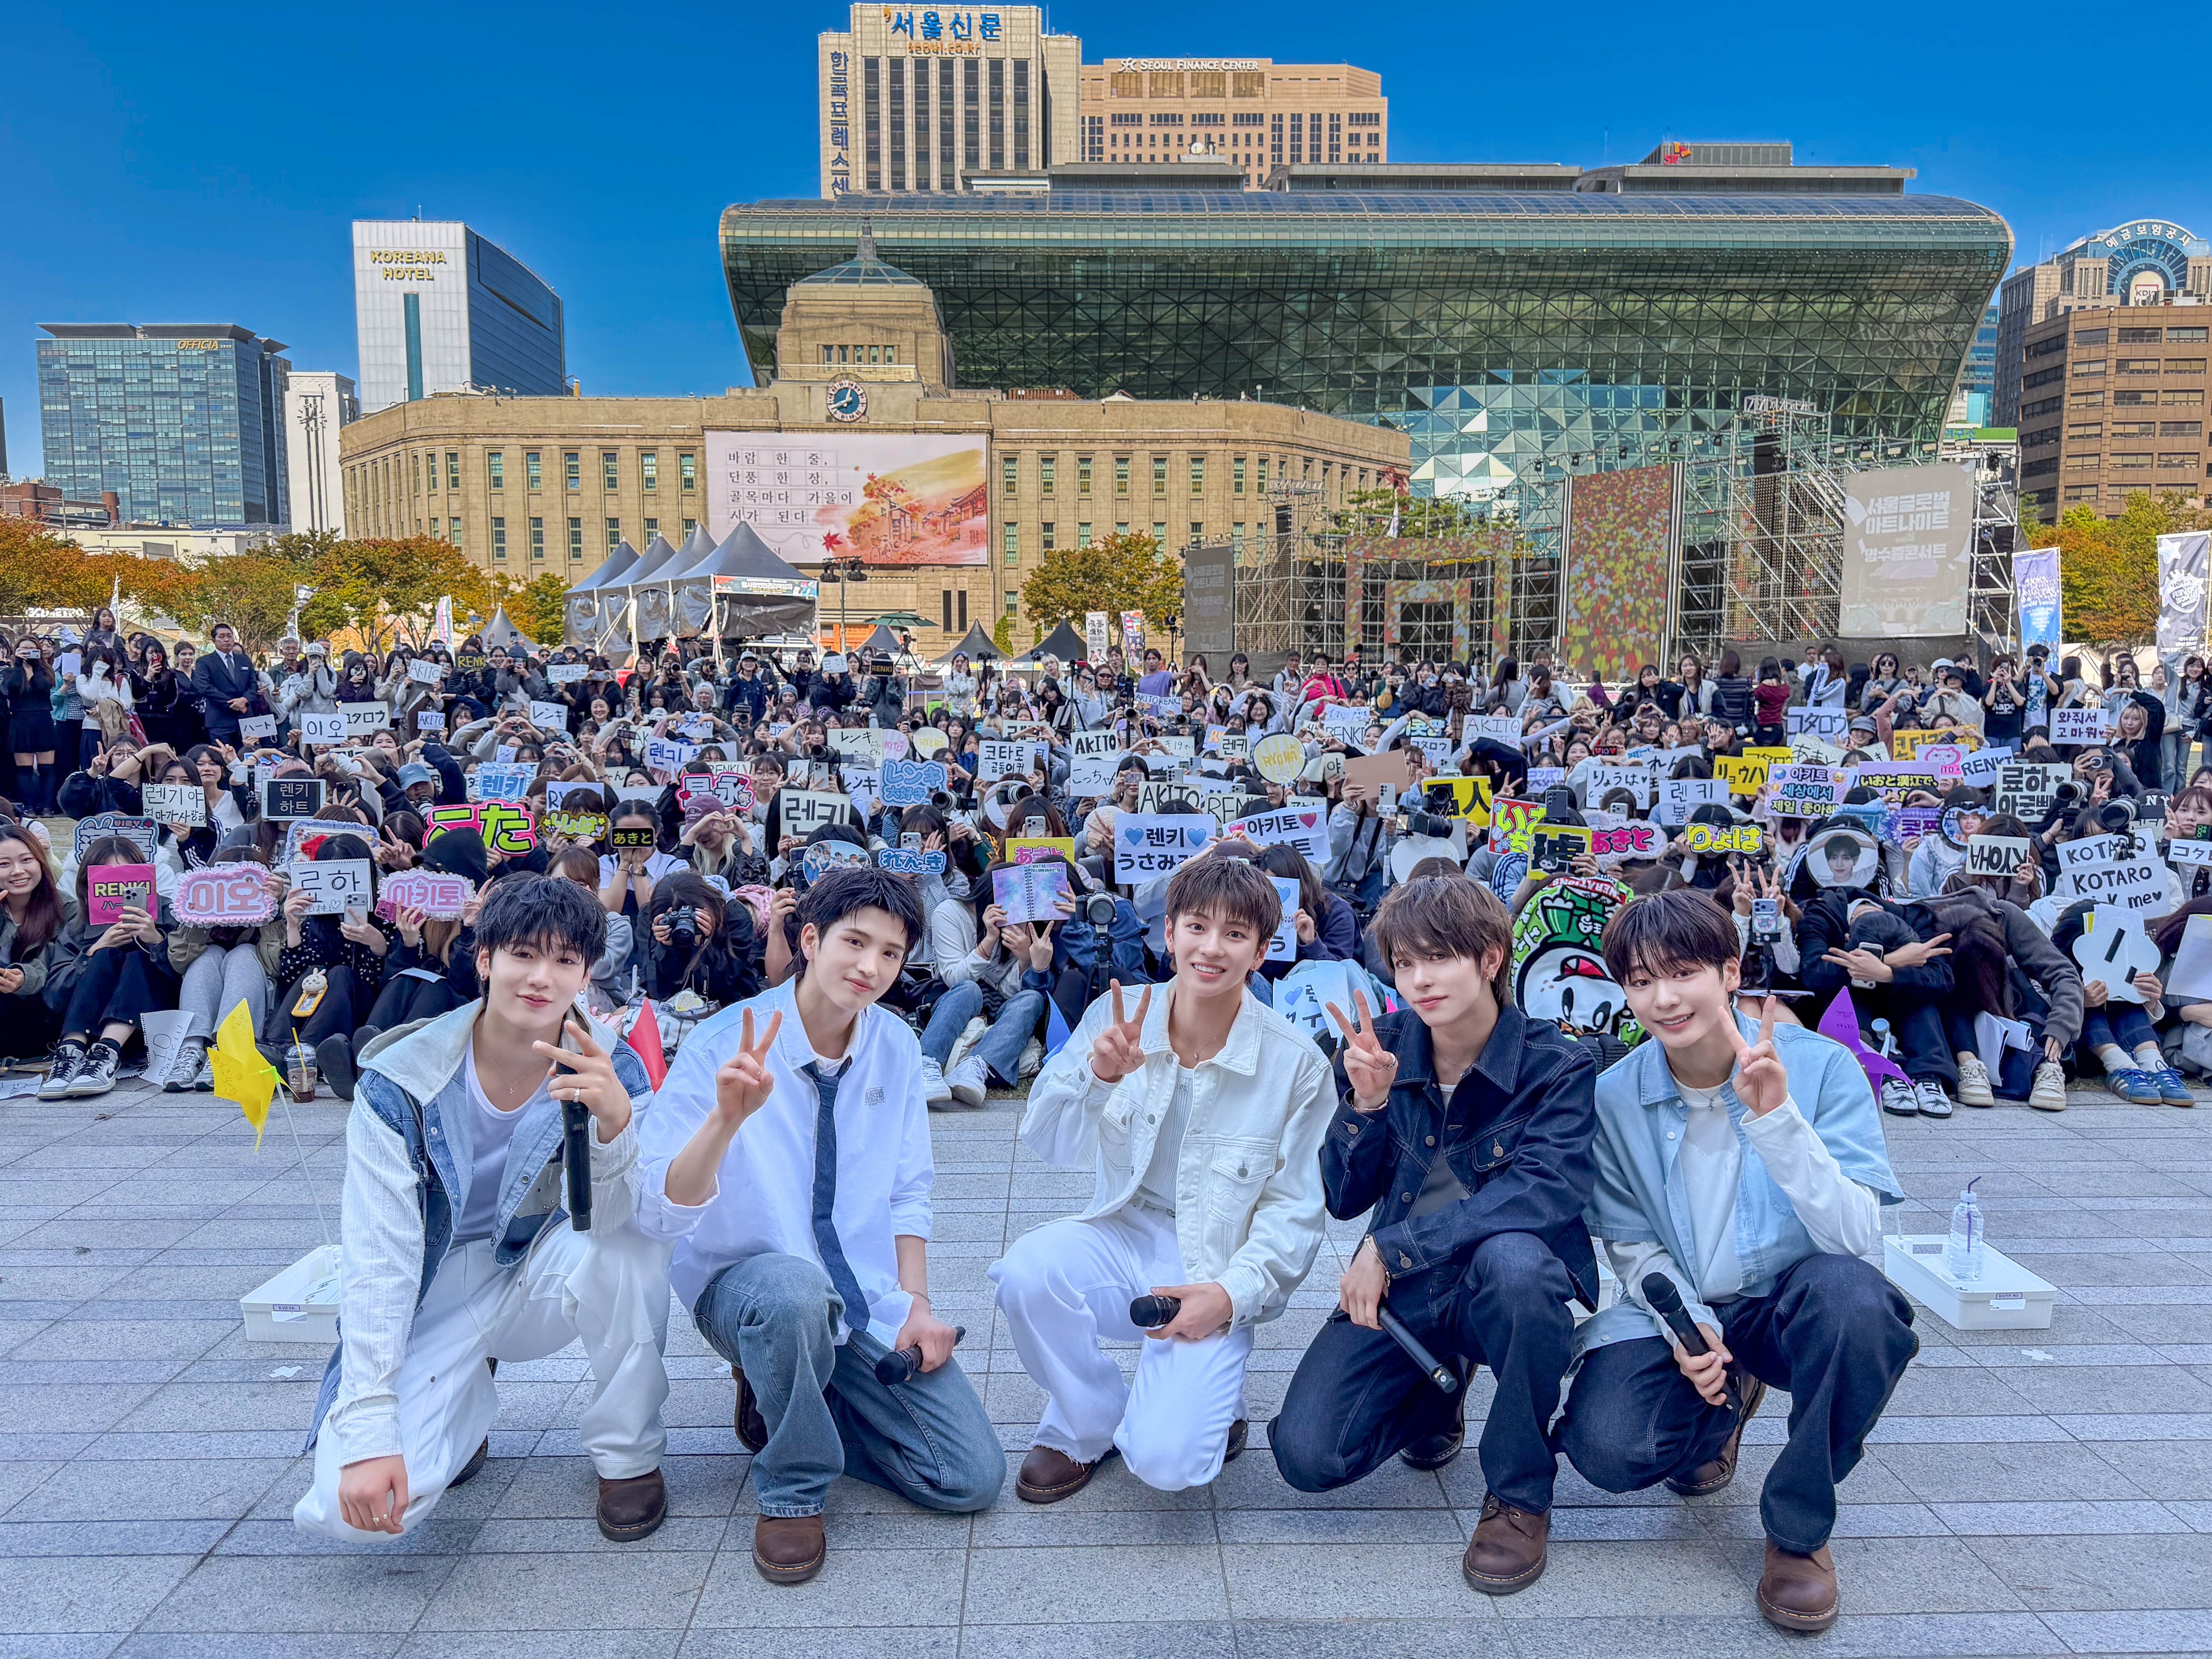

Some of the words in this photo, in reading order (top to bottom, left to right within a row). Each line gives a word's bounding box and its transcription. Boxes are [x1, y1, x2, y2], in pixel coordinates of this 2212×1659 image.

[891, 11, 1002, 41] 서울신문
[909, 40, 981, 56] seoul.co.kr
[1140, 60, 1174, 71] SEOUL
[1177, 60, 1220, 71] FINANCE
[1221, 60, 1259, 71] CENTER
[2105, 223, 2191, 248] 예금보험공사
[370, 251, 447, 264] KOREANA
[382, 268, 434, 281] HOTEL
[178, 340, 219, 351] OFFICIA
[729, 451, 756, 465] 바람
[776, 452, 788, 466] 한
[808, 453, 828, 466] 줄,
[729, 470, 757, 484] 단풍
[778, 471, 788, 485] 한
[808, 472, 828, 486] 장,
[729, 490, 790, 504] 골목마다
[808, 491, 852, 504] 가을이
[1867, 491, 1950, 515] 서울글로벌
[730, 508, 759, 522] 시가
[778, 509, 806, 523] 된다
[1865, 512, 1949, 535] 아트나이트
[1135, 694, 1158, 705] AKITO
[419, 714, 445, 725] AKITO
[532, 705, 563, 724] レンキ
[2057, 712, 2097, 724] 와줘서
[307, 720, 345, 737] 이오
[1467, 718, 1520, 733] AKITO
[1788, 714, 1846, 735] コタロウ
[841, 730, 873, 744] レンキ
[1075, 734, 1116, 755] AKITO
[1411, 740, 1447, 751] コタロウ
[985, 745, 1024, 761] 코타로
[1222, 738, 1247, 755] 렌키
[885, 762, 942, 785] レンキ
[1718, 763, 1767, 784] リョウハ
[1963, 755, 2012, 777] RENKI
[1072, 767, 1117, 787] こっちゃん
[1593, 769, 1639, 787] りょうは
[1790, 767, 1829, 783] 아키토
[2002, 766, 2050, 792] 료하
[279, 783, 309, 798] 렌키
[482, 774, 526, 799] 렌키
[885, 786, 926, 801] 大好き
[1780, 783, 1834, 801] 세상에서
[1140, 784, 1200, 813] AKITO
[1770, 799, 1796, 814] 제일
[2145, 795, 2171, 807] NY
[280, 800, 310, 815] 하트
[786, 797, 846, 836] 렌키
[1247, 814, 1300, 837] 아키토
[614, 831, 652, 845] あきと
[1146, 828, 1184, 848] 렌키
[1592, 826, 1655, 855] あきと
[2066, 837, 2148, 864] KOTAO
[881, 852, 944, 872] れんき
[2072, 866, 2152, 895] KOTARO
[192, 878, 262, 913] 이오
[394, 883, 461, 906] 아키토
[2128, 892, 2152, 909] me
